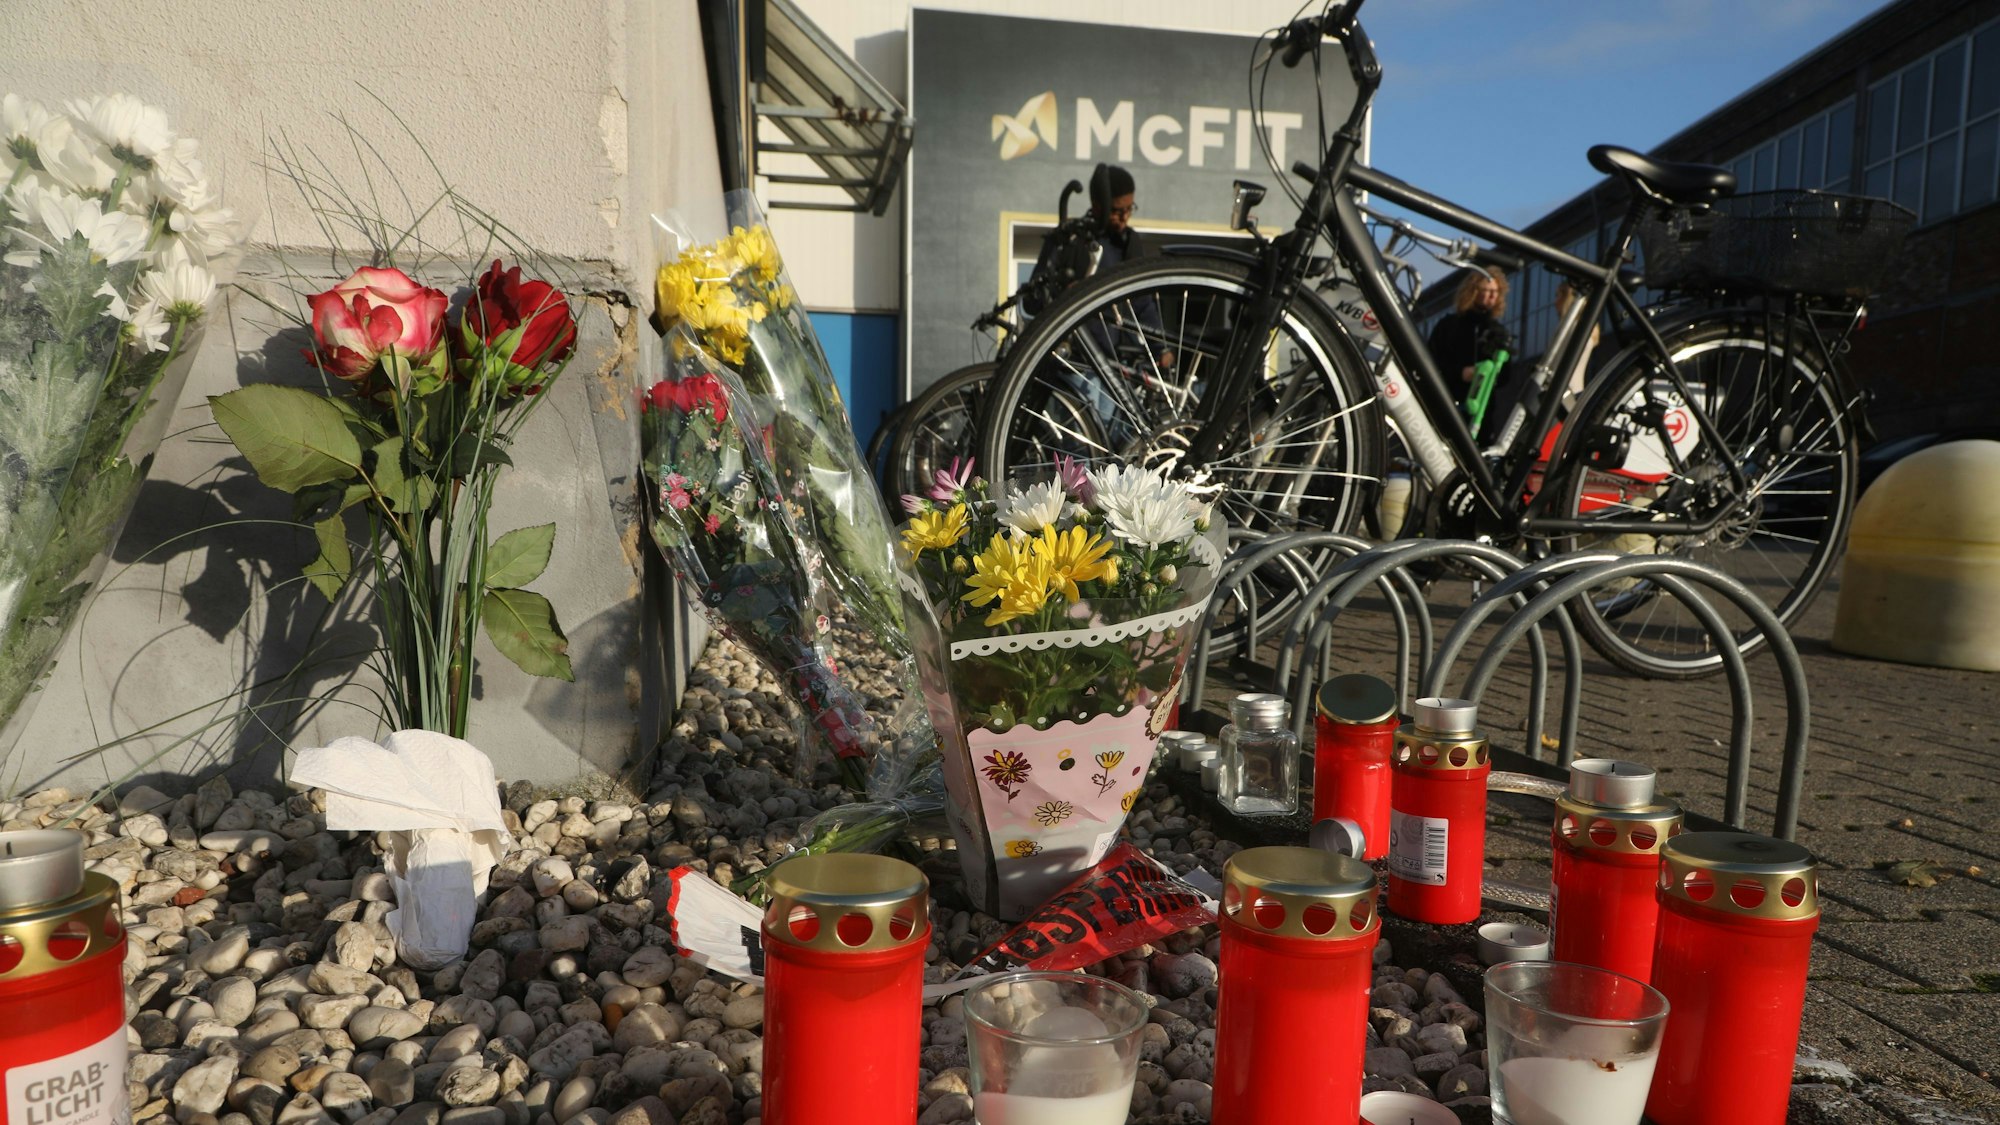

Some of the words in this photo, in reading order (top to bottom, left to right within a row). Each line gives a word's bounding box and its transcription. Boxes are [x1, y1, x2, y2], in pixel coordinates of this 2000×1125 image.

[1075, 97, 1303, 171] McFIT
[1335, 300, 1364, 319] KVB
[1400, 408, 1450, 485] nextbik
[25, 1061, 109, 1102] GRAB-
[26, 1081, 104, 1125] LICHT
